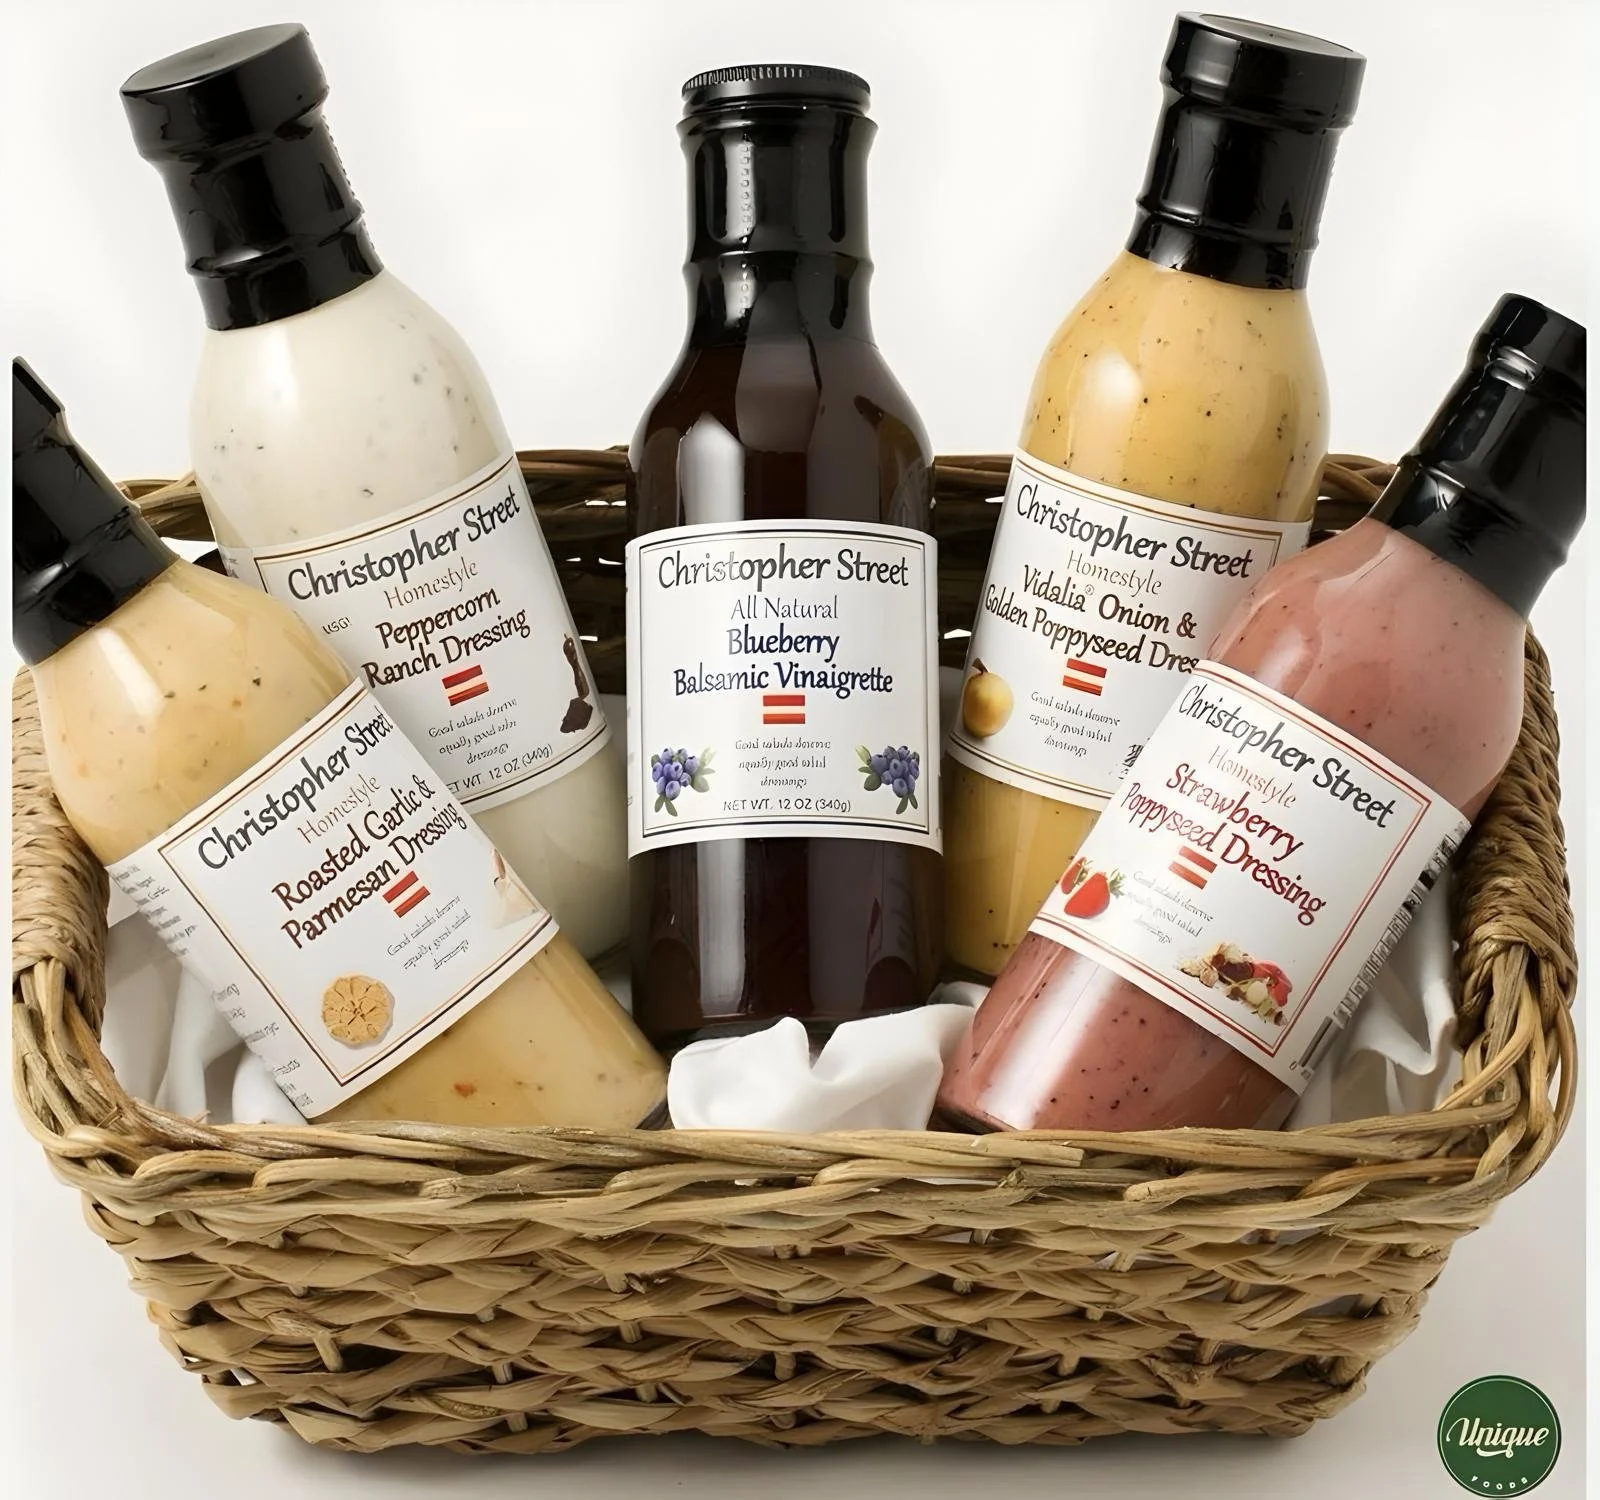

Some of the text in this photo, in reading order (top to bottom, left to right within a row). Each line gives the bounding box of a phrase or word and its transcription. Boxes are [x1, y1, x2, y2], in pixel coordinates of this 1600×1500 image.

[288, 485, 520, 600] Christopher Street
[1017, 484, 1253, 578] Christopher Street
[384, 557, 479, 609] Homestyle
[659, 543, 909, 592] Christopher Street
[1066, 550, 1162, 597] Homestyle
[376, 588, 500, 649] Peppercorn
[731, 595, 838, 620] All Natural
[985, 584, 1200, 674] Golden Poppyseed Dre
[1098, 594, 1169, 633] Onion
[1176, 612, 1197, 639] &
[361, 609, 531, 688] Ranch Dressing
[727, 623, 840, 663] Blueberry
[674, 662, 893, 699] Balsamic Vinaigrette
[446, 781, 460, 794] ET
[489, 767, 502, 780] 12
[1178, 685, 1396, 830] Christopher Street
[1207, 745, 1296, 808] Homestyle
[198, 744, 351, 870] Christopher
[297, 772, 381, 845] Homestyle
[723, 799, 747, 811] NET
[779, 799, 791, 810] 12
[794, 798, 812, 810] OZ
[1166, 763, 1304, 862] Strawberry
[271, 774, 436, 911] Roasted Garlic &
[280, 859, 400, 950] Parmesan
[388, 801, 468, 867] Dressing
[1120, 782, 1225, 854] Poppyseed
[1220, 833, 1327, 926] Dressing
